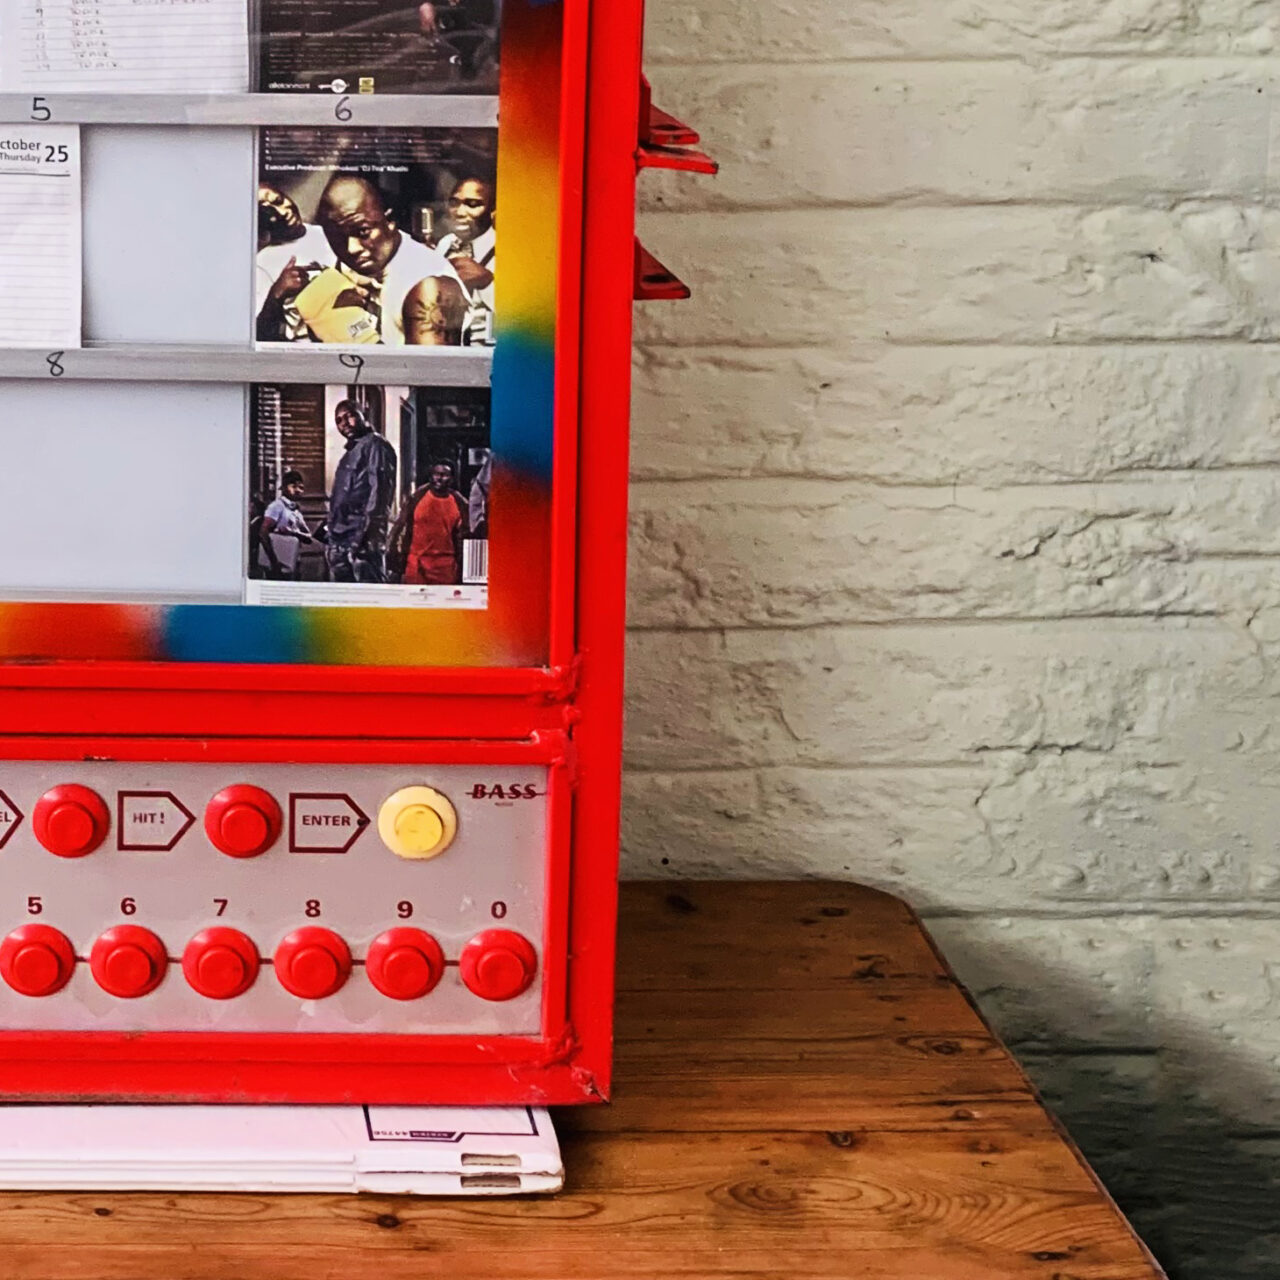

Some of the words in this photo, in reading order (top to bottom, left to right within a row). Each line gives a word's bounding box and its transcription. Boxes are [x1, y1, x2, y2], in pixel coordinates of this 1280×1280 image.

[31, 97, 52, 121] 5
[334, 96, 353, 121] 6
[0, 152, 41, 164] Thursday
[44, 145, 70, 163] 25
[46, 351, 65, 376] 8
[338, 353, 364, 384] 9
[472, 783, 537, 800] BASS
[301, 814, 351, 827] ENTER
[27, 897, 43, 915] 5
[120, 897, 137, 915] 6
[213, 899, 228, 916] 7
[305, 900, 321, 918] 8
[397, 900, 413, 919] 9
[491, 901, 507, 919] 0
